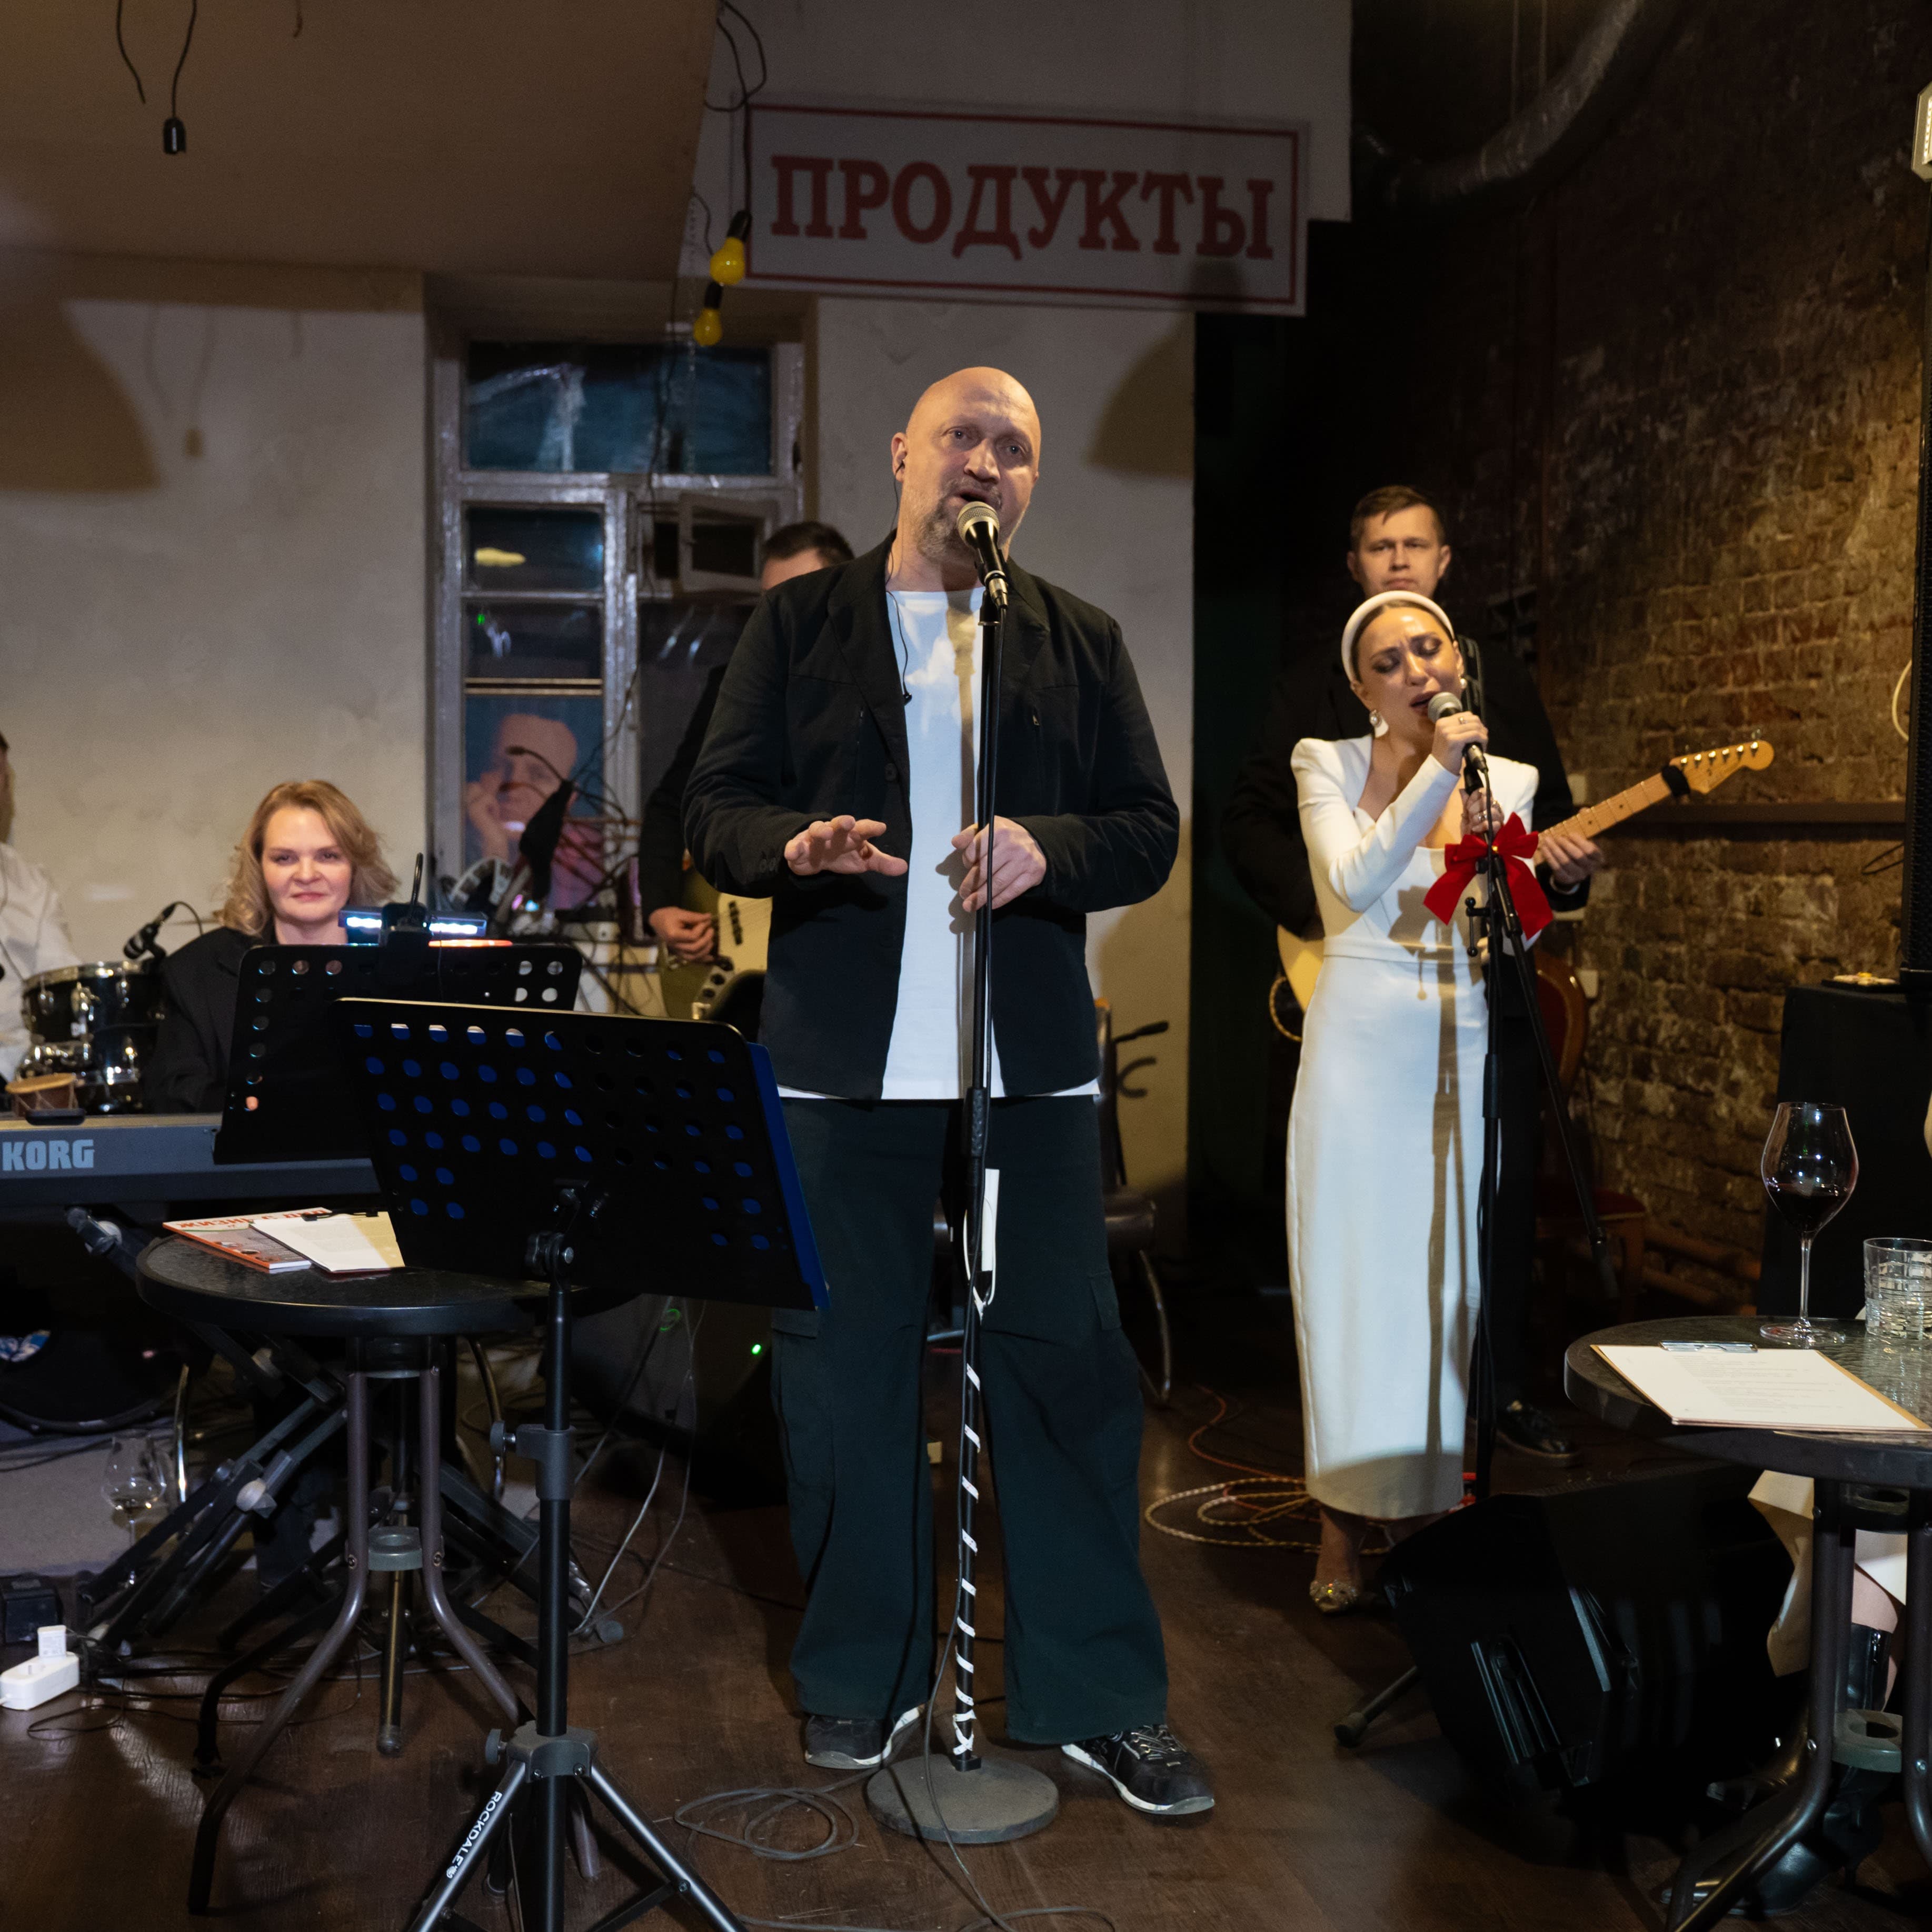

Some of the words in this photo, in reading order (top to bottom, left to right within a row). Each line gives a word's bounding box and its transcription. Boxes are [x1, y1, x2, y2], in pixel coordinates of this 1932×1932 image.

[770, 154, 1275, 262] ПРОДУКТЫ
[2, 1139, 95, 1171] KORG
[452, 1791, 503, 1866] ROCKDALE
